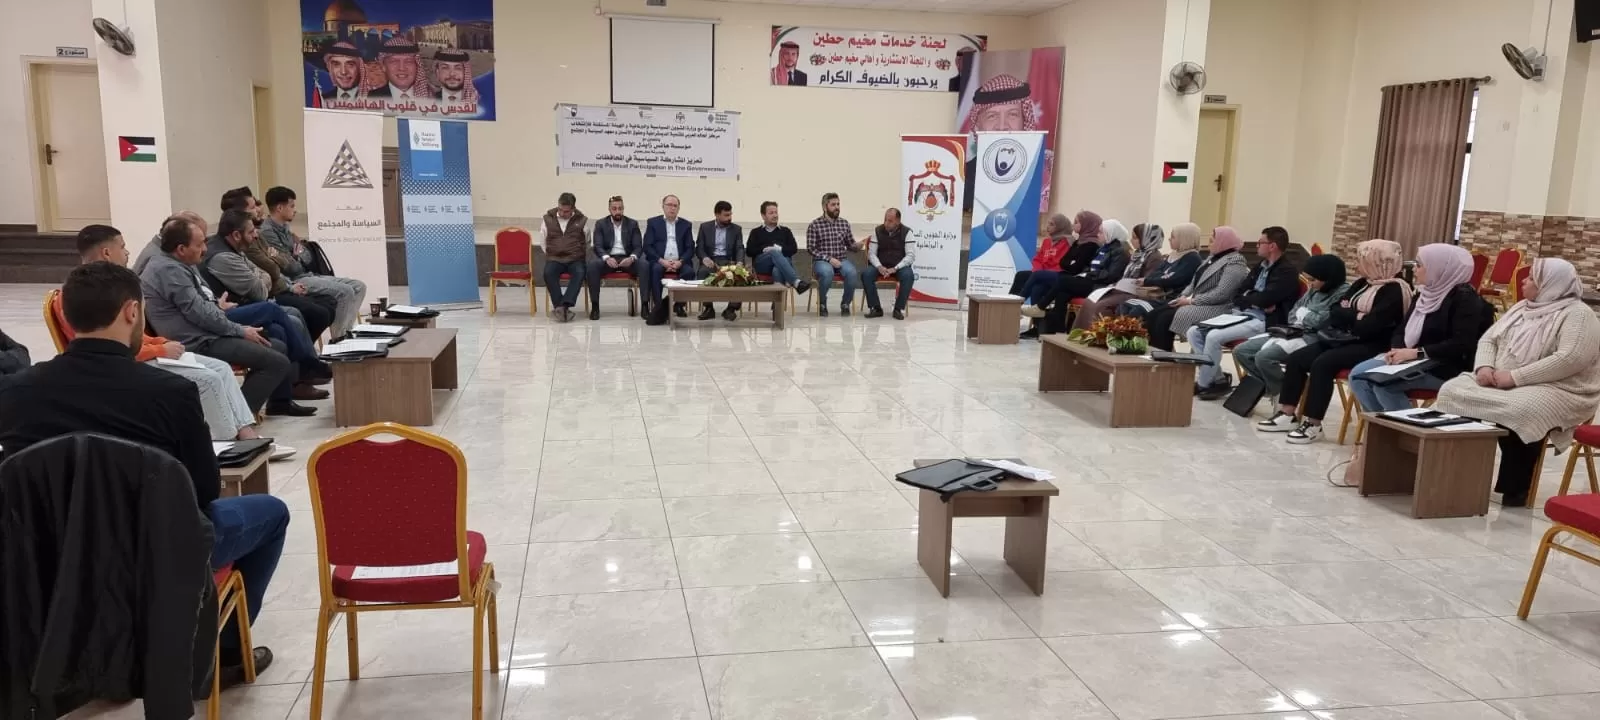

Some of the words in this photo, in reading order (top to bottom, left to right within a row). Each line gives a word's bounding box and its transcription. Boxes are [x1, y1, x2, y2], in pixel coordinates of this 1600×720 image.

[812, 32, 844, 46] حطين
[848, 34, 876, 48] مخيم
[880, 34, 916, 48] خدمات
[920, 35, 946, 52] لجنة
[820, 70, 852, 84] الكرام
[856, 70, 900, 87] بالضيوف
[904, 76, 938, 89] يرحبون
[387, 101, 418, 113] قلوب
[419, 102, 438, 116] في
[440, 103, 477, 115] القدس
